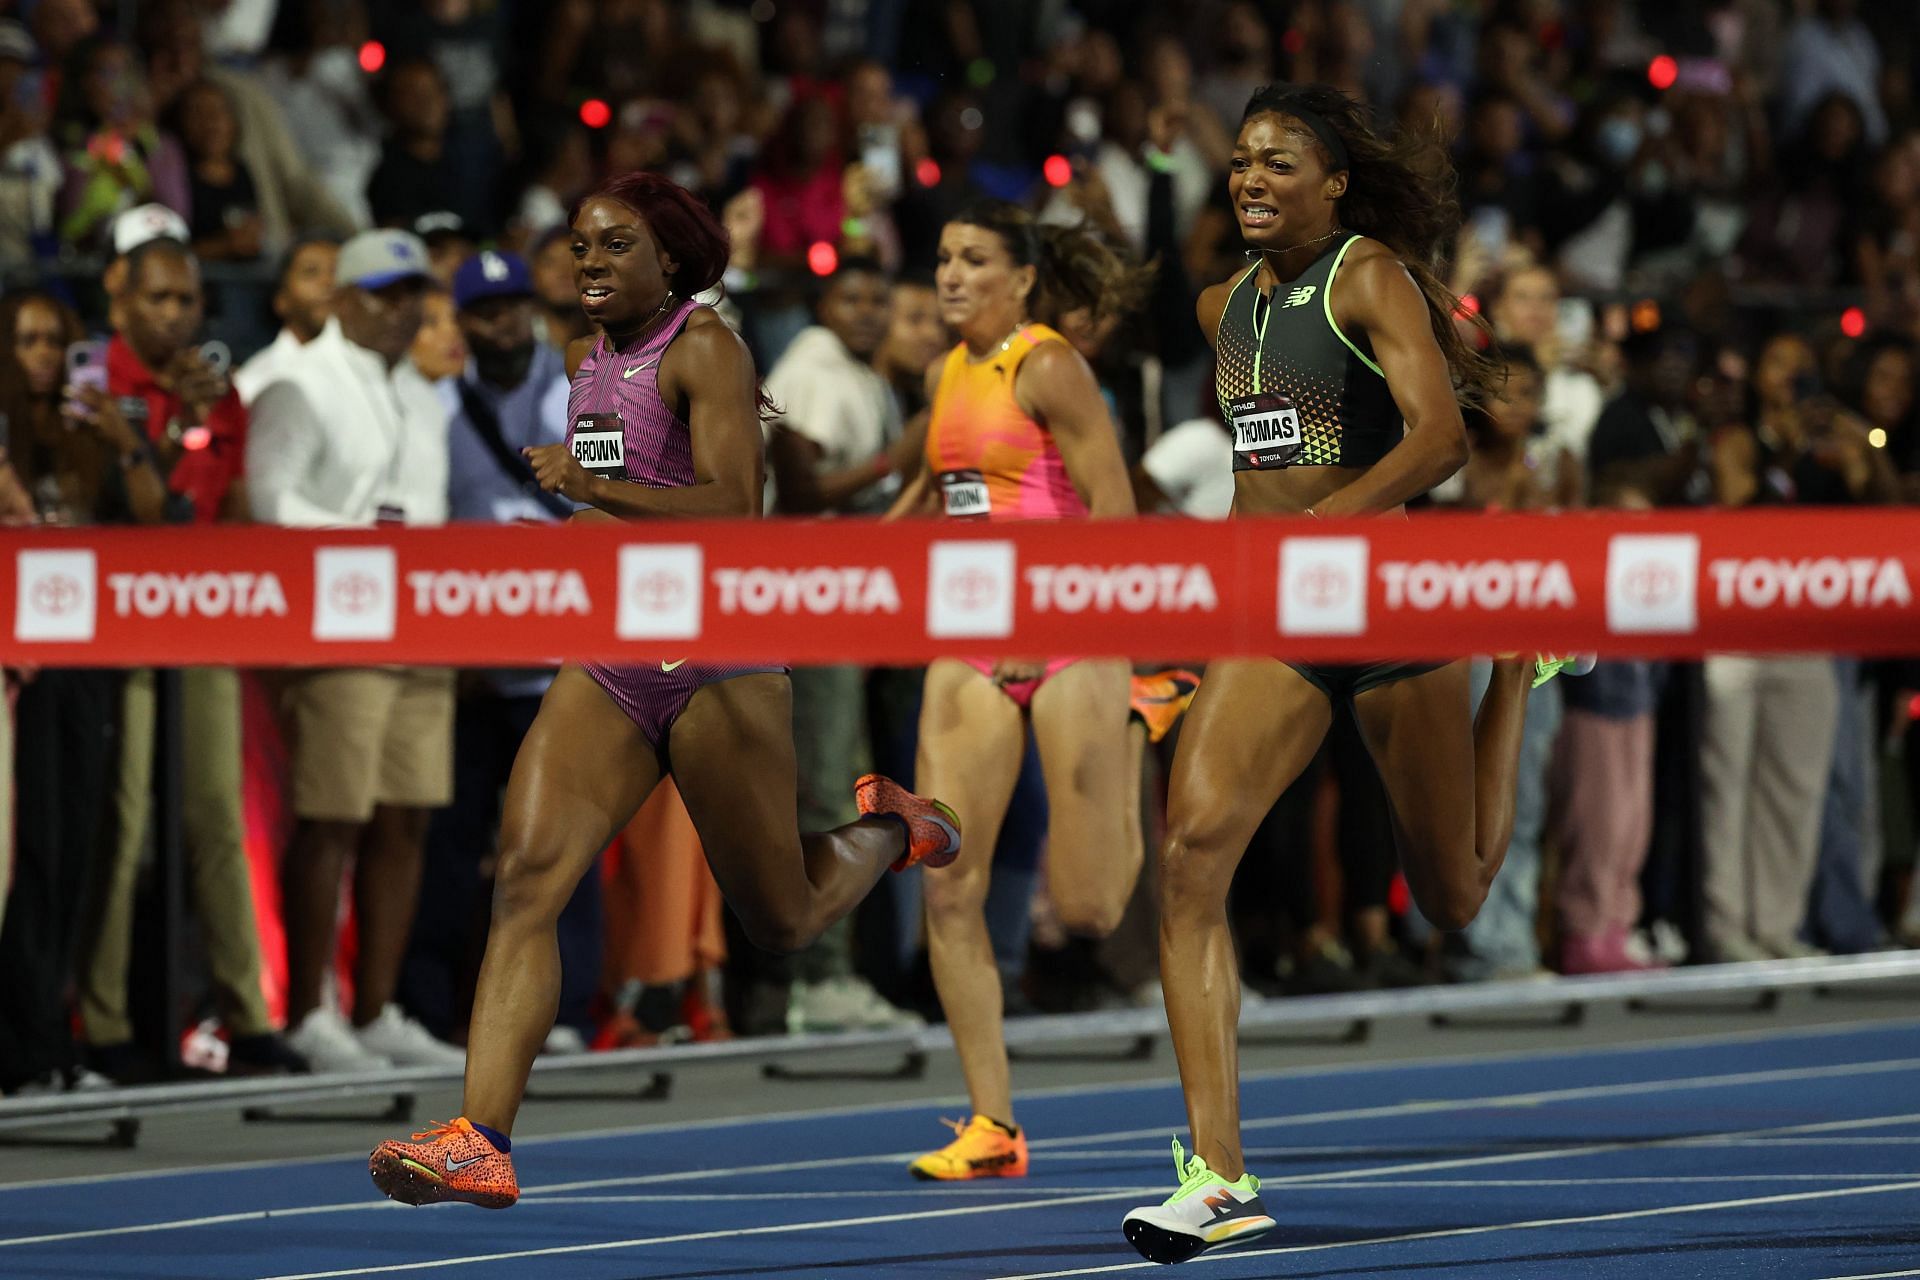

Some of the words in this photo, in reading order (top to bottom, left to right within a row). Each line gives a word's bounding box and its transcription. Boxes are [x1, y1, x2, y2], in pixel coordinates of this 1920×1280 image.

[1238, 416, 1295, 444] THOMAS
[575, 439, 621, 462] BROWN
[1259, 453, 1281, 463] TOYOTA
[109, 572, 287, 617] TOYOTA
[407, 569, 591, 615] TOYOTA
[713, 567, 899, 614] TOYOTA
[1026, 564, 1217, 611] TOYOTA
[1379, 560, 1575, 609] TOYOTA
[1710, 558, 1910, 606] TOYOTA
